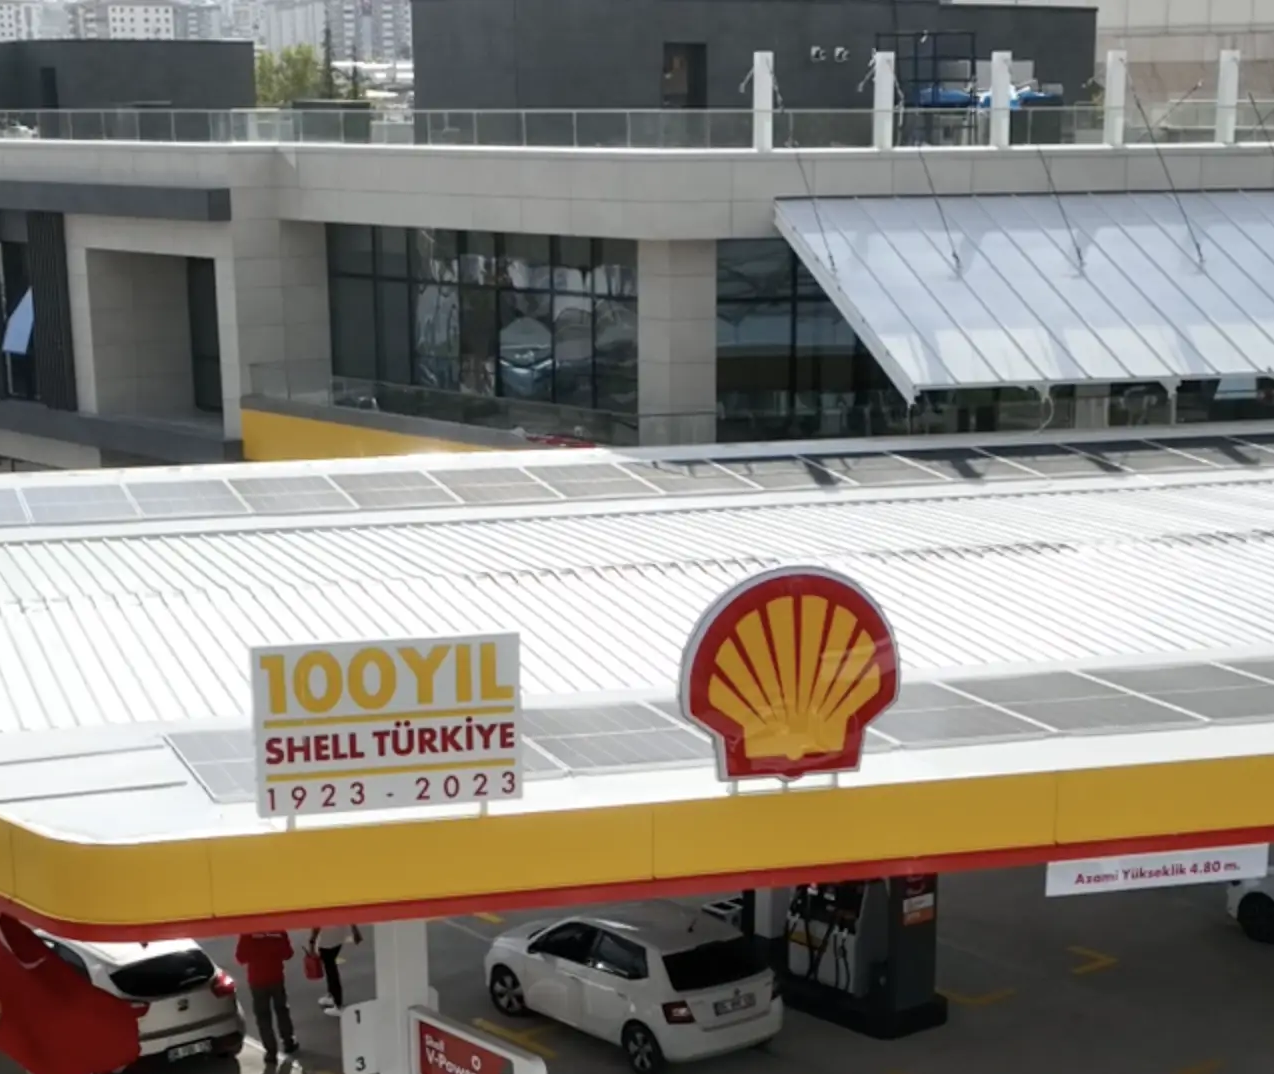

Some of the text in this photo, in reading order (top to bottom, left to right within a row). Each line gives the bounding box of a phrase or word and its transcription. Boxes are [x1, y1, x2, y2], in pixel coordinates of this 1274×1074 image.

[265, 716, 515, 765] SHELL TÜRKİYE
[267, 781, 366, 811] 1923
[416, 771, 516, 800] 2023
[1075, 860, 1241, 885] Azami Yükseklik 4.80 m.
[354, 1009, 361, 1025] 1
[355, 1056, 366, 1072] 3
